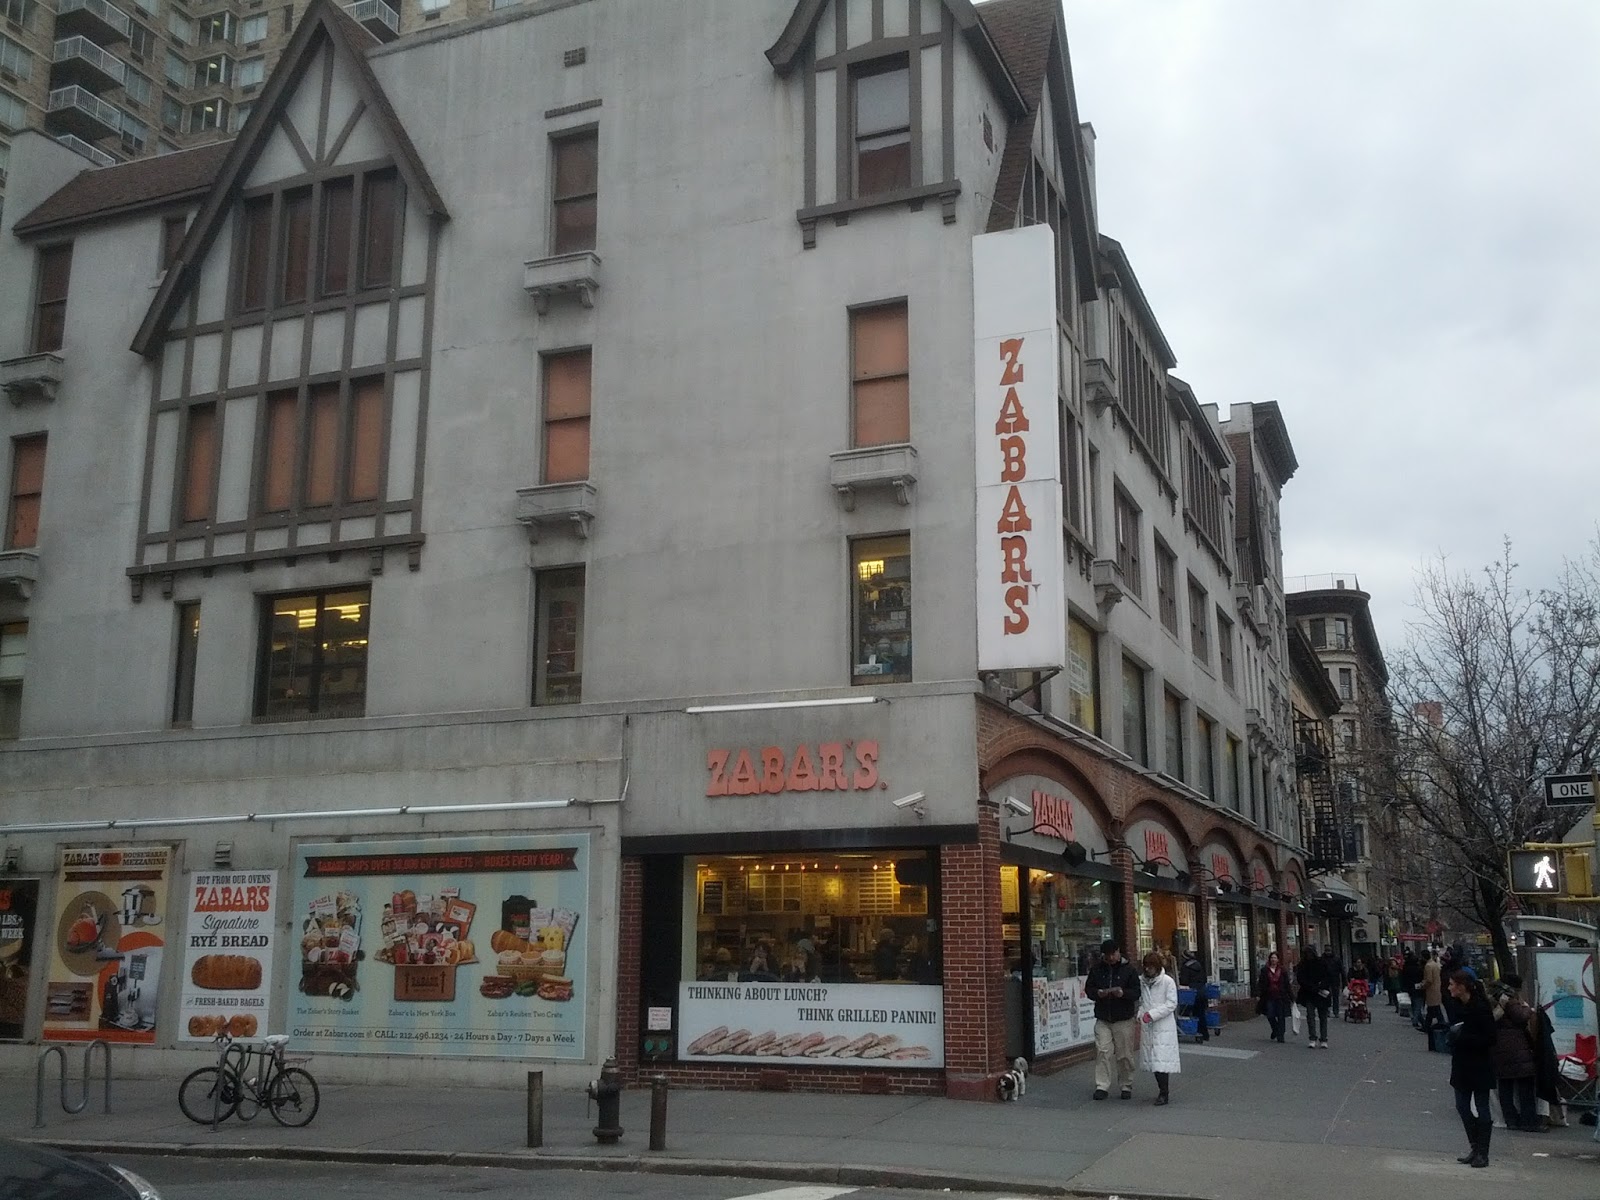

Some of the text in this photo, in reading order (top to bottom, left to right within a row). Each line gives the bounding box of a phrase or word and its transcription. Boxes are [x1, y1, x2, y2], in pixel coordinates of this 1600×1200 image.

[1560, 784, 1589, 796] ONE
[122, 858, 167, 866] MEZZANINE
[512, 854, 537, 866] EVERY
[540, 853, 564, 865] YEAR!
[196, 875, 271, 885] HOT FROM OUR OVENS
[202, 914, 260, 937] Signature
[191, 935, 269, 947] RYE BREAD
[687, 986, 828, 1001] THINKING ABOUT LUNCH?
[194, 998, 239, 1006] FRESH-BAKED
[240, 998, 264, 1006] BAGELS
[416, 1009, 430, 1017] New
[430, 1009, 444, 1017] York
[510, 1010, 531, 1018] Reuben
[546, 1011, 563, 1019] Crate
[797, 1008, 937, 1024] THINK GRILLED PANINI!
[293, 1028, 315, 1037] Order
[316, 1029, 323, 1037] at
[324, 1029, 365, 1038] Zabars.com
[375, 1030, 398, 1038] CALL:
[400, 1032, 449, 1041] 212.496.1234
[465, 1032, 489, 1041] Hours
[497, 1032, 513, 1043] Day
[518, 1034, 523, 1042] 7
[525, 1033, 545, 1044] Days
[553, 1033, 576, 1043] Week
